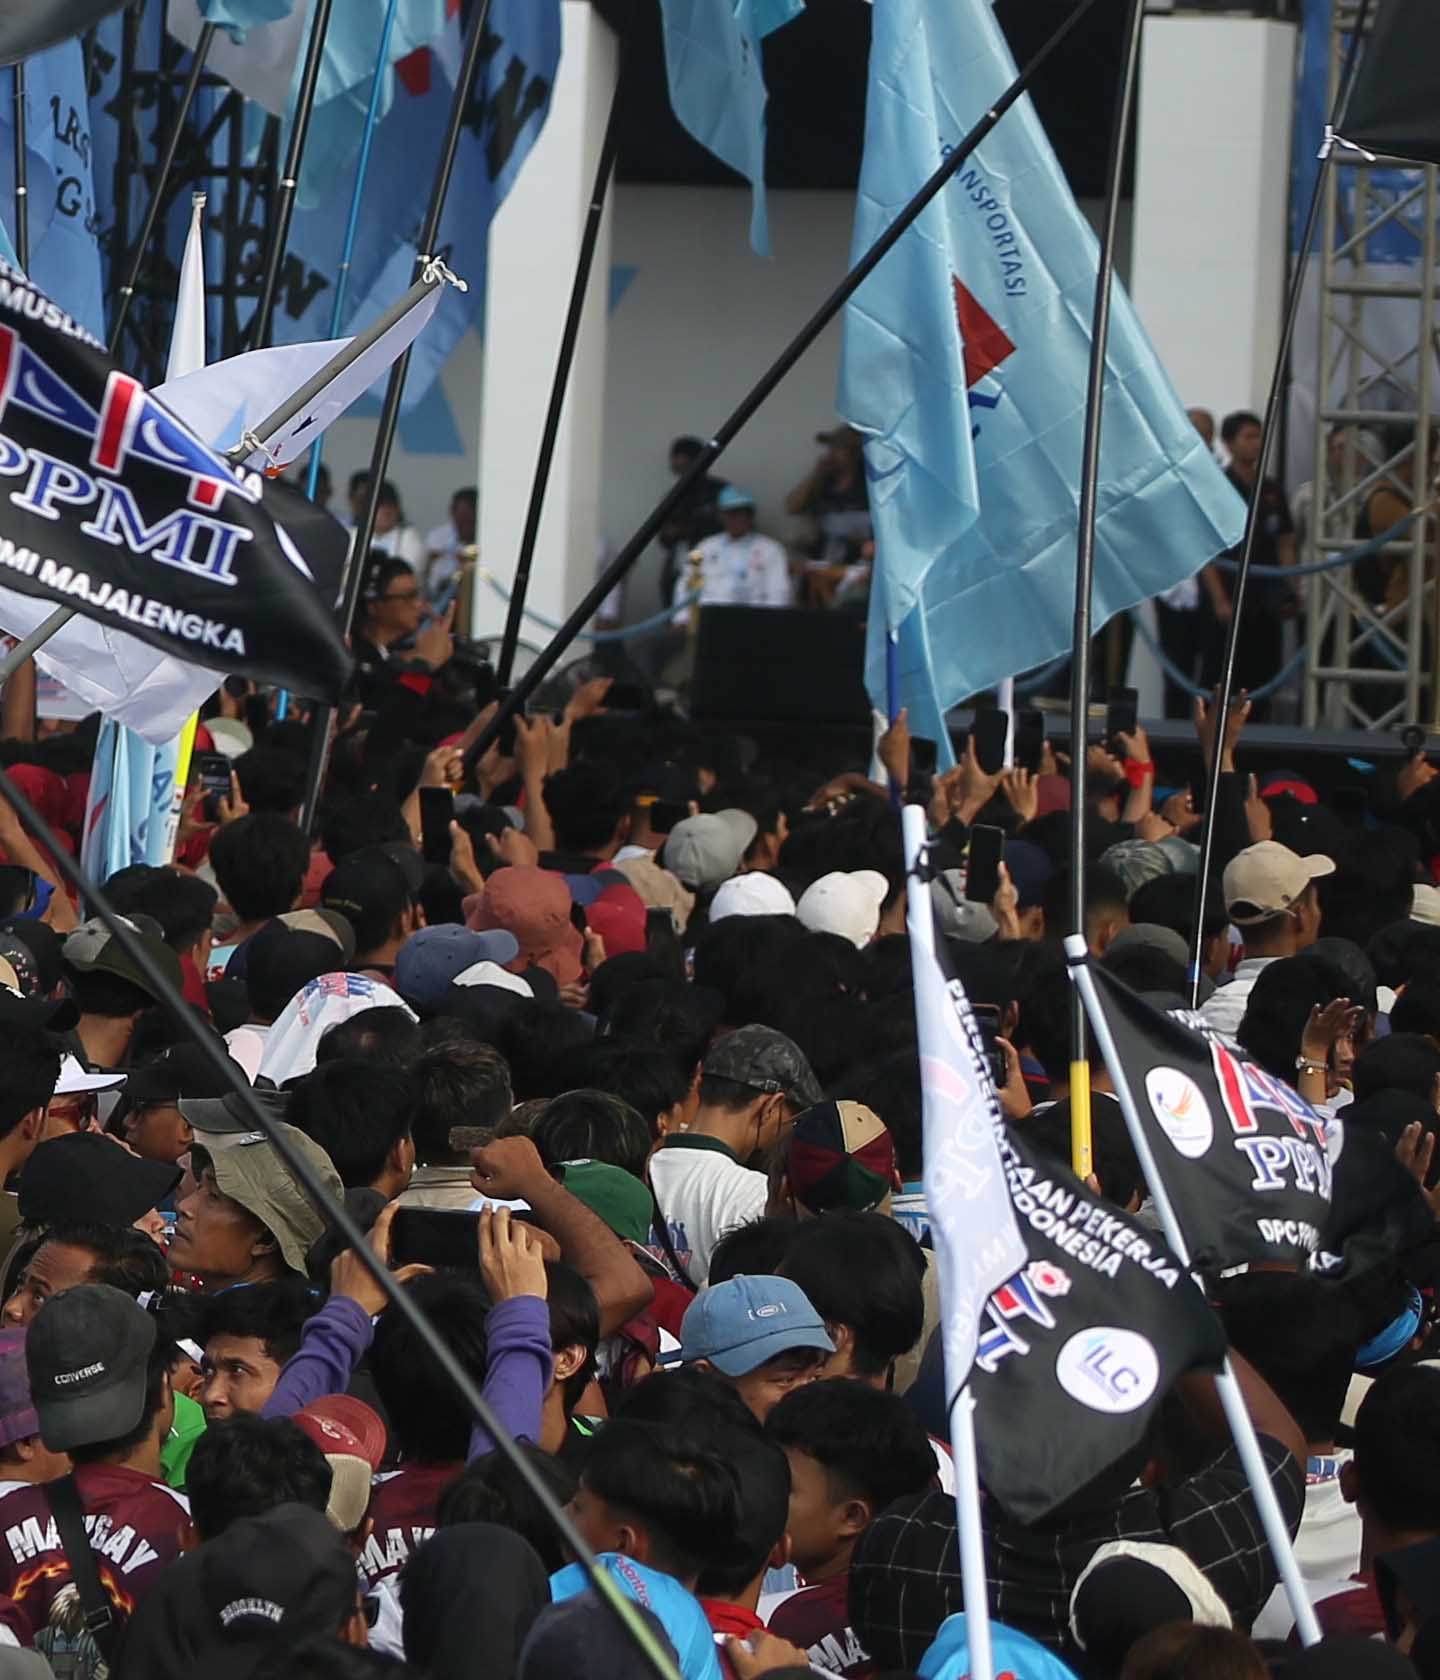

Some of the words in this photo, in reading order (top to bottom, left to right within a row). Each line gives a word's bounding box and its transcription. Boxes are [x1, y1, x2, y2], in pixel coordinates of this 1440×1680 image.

[938, 134, 1027, 298] RNSPORTASI
[39, 559, 246, 656] MAJALENGKA
[1069, 1196, 1181, 1289] PEKERJA
[54, 1361, 105, 1386] CONVERSE
[1085, 1342, 1140, 1397] ILC
